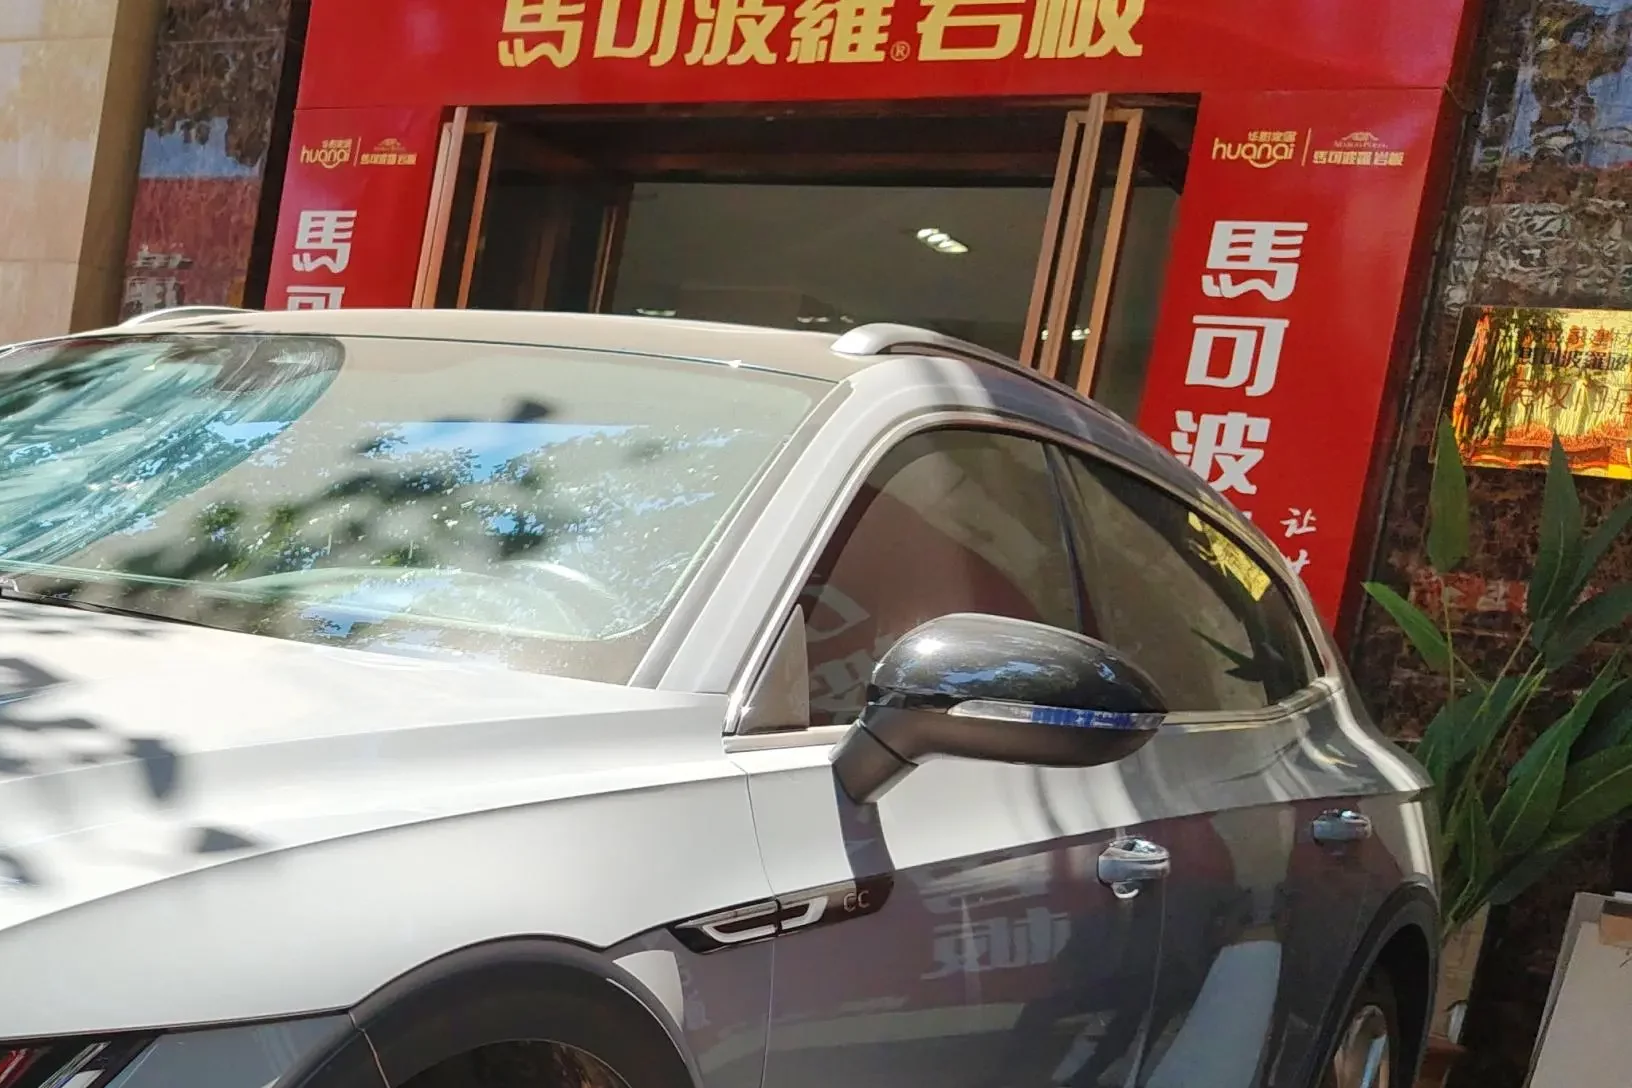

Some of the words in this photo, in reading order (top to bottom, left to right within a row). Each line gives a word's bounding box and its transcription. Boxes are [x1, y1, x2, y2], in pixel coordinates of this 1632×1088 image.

[1211, 137, 1295, 169] huanai
[1171, 220, 1309, 520] 馬可波
